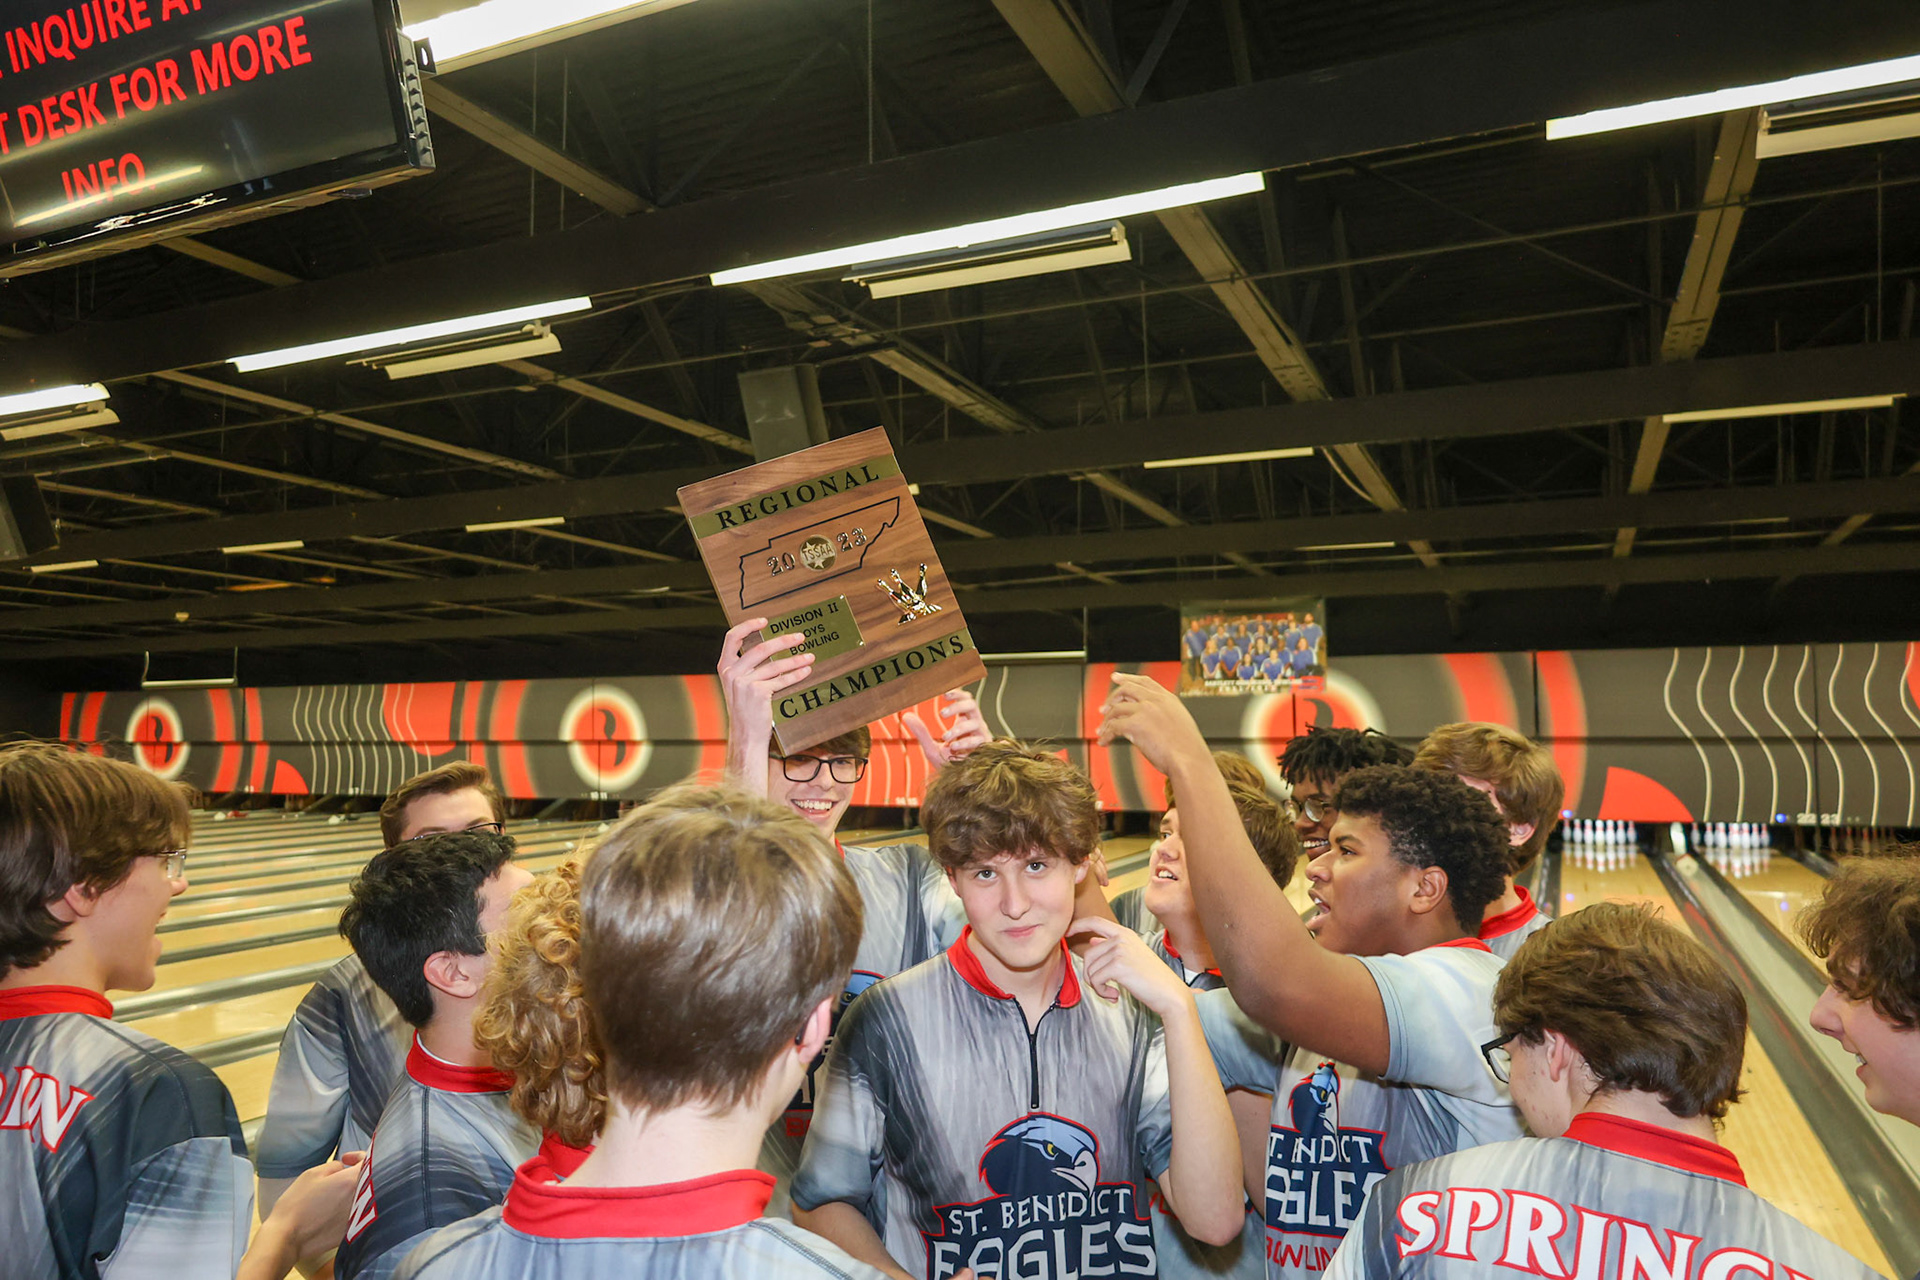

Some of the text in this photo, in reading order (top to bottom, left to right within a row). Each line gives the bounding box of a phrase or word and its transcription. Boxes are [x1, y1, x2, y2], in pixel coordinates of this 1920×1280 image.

[5, 0, 153, 73] INQUIRE
[20, 82, 107, 148] DESK
[110, 58, 187, 119] FOR
[190, 16, 313, 96] MORE
[715, 465, 881, 531] REGIONAL
[801, 543, 835, 562] TSSAA
[769, 608, 824, 635] DIVISION
[789, 631, 840, 656] BOWLING
[802, 623, 826, 638] OYS
[778, 634, 965, 719] CHAMPIONS
[948, 1207, 988, 1237] ST.
[1265, 1164, 1387, 1230] AGLE
[932, 1221, 1156, 1280] EAGLES
[1394, 1187, 1816, 1280] SPRIN
